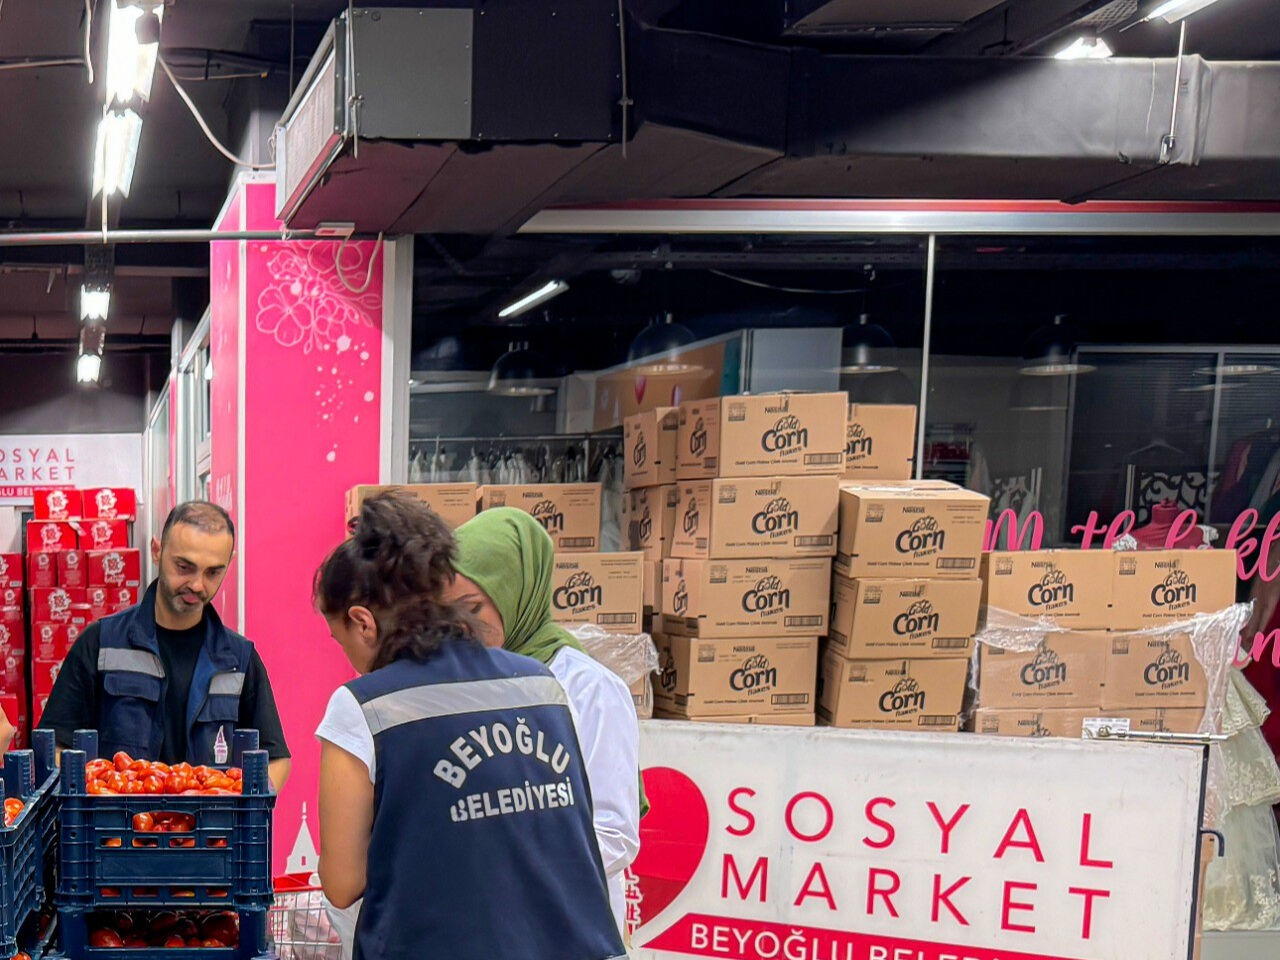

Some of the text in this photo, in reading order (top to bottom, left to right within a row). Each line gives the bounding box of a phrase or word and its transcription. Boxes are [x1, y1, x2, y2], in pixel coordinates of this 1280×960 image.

[761, 426, 808, 453] Corn
[751, 510, 799, 535] Corn
[895, 528, 945, 554] Corn
[552, 585, 602, 610] Corn
[742, 588, 790, 613] Corn
[1027, 582, 1074, 607] Corn
[1150, 582, 1197, 607] Corn
[892, 611, 940, 636] Corn
[729, 666, 777, 692] Corn
[1020, 661, 1067, 686] Corn
[1143, 661, 1190, 686] Corn
[878, 690, 926, 713] Corn
[433, 716, 570, 789] BEYOĞLU
[450, 776, 574, 822] BELEDİYESİ
[724, 786, 1114, 869] SOSYAL
[720, 853, 1111, 940] MARKET
